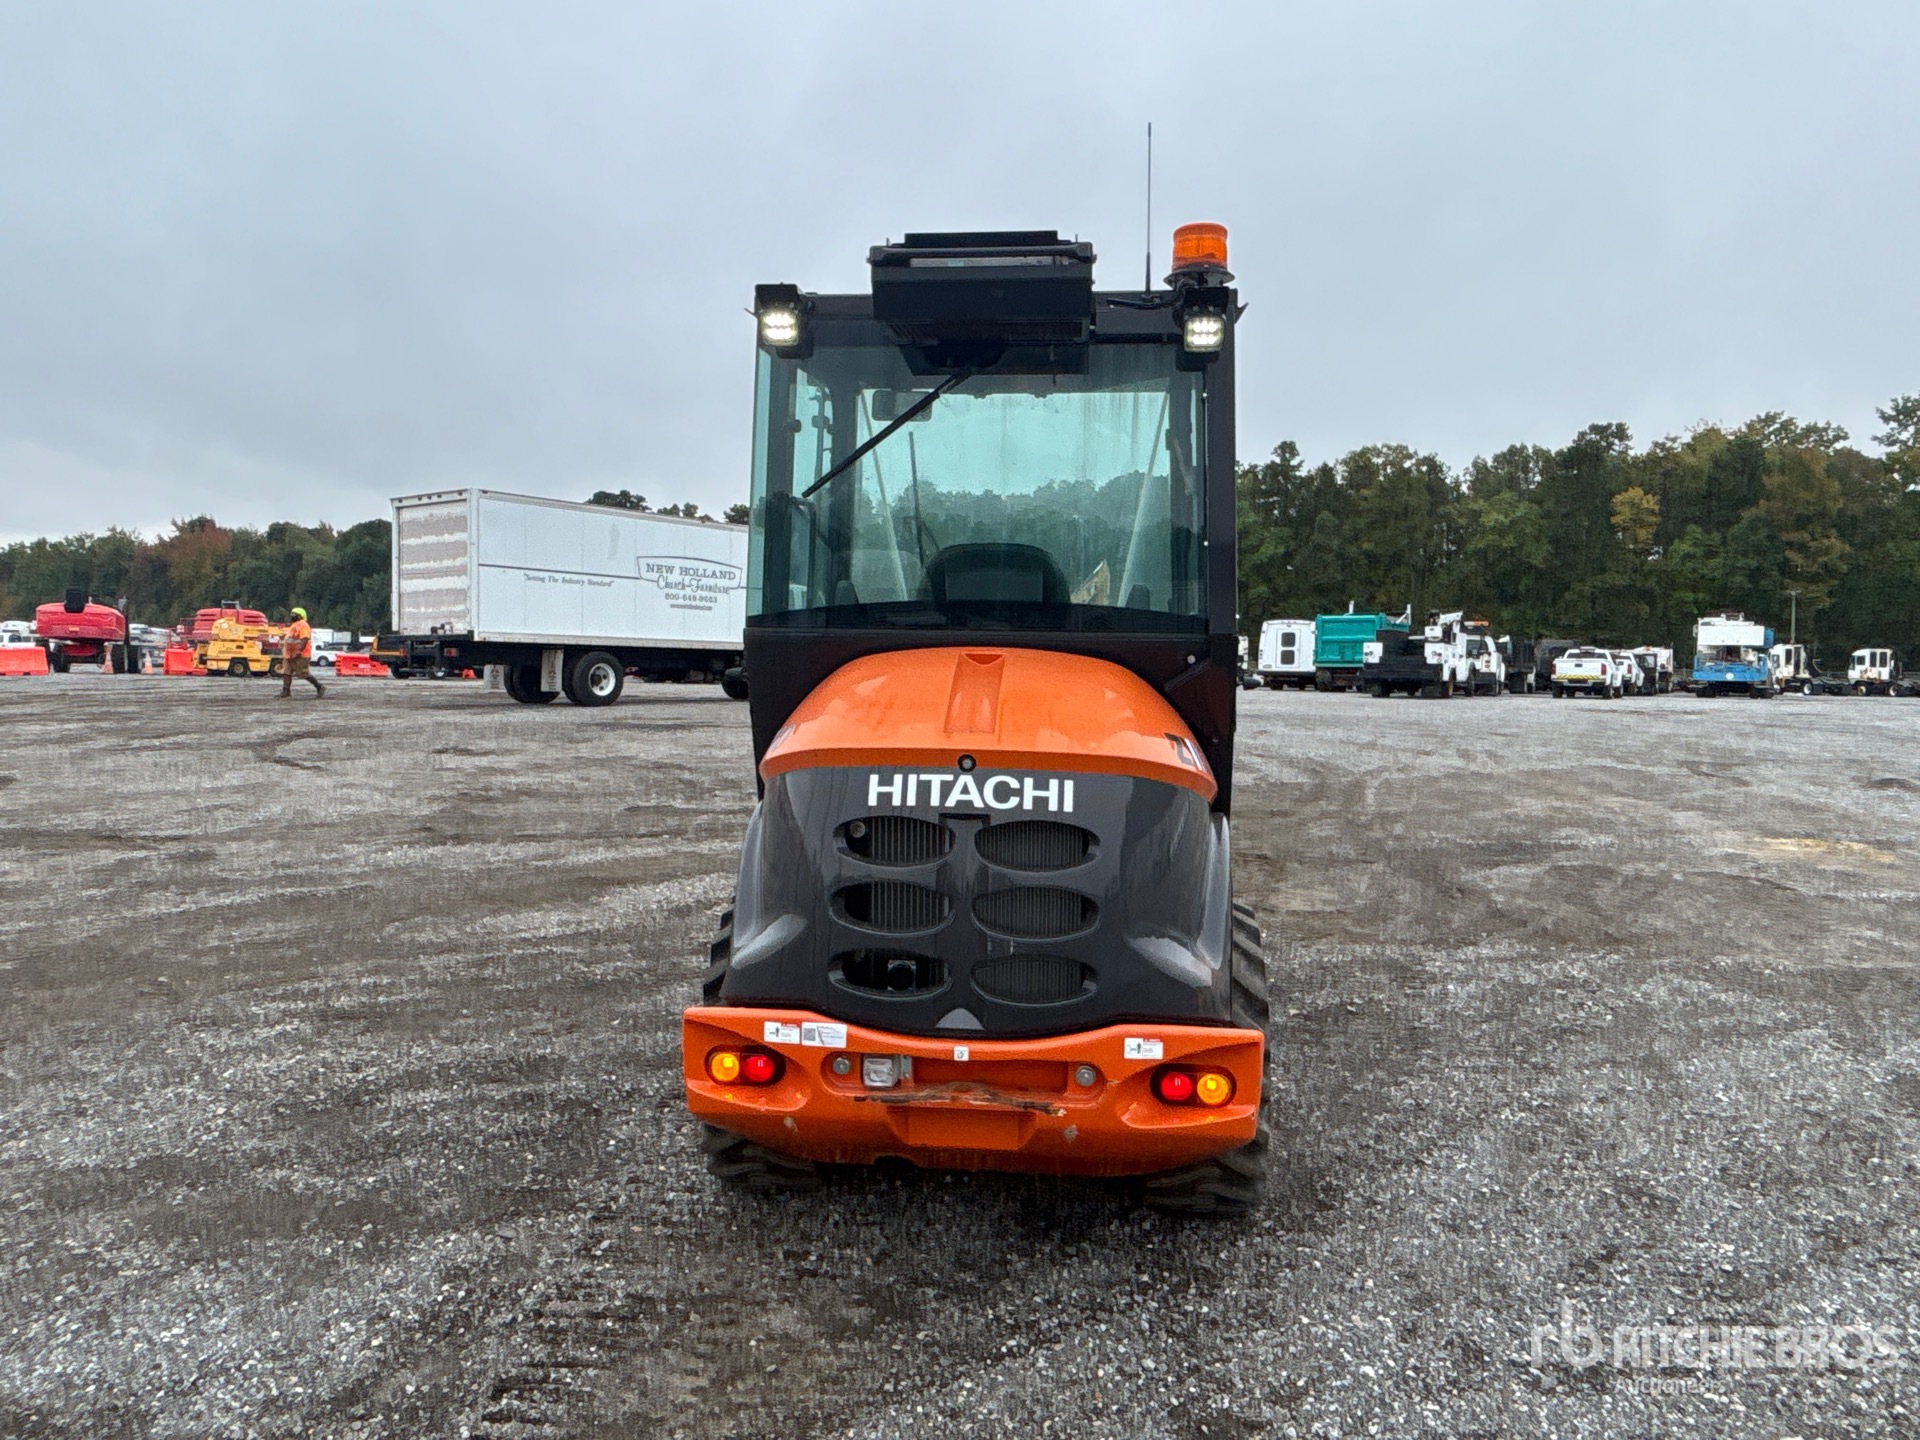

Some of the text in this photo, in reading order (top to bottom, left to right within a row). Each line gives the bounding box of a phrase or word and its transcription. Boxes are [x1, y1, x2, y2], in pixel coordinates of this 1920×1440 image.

[645, 563, 737, 581] NEW HOLLAND
[867, 773, 1075, 813] HITACHI
